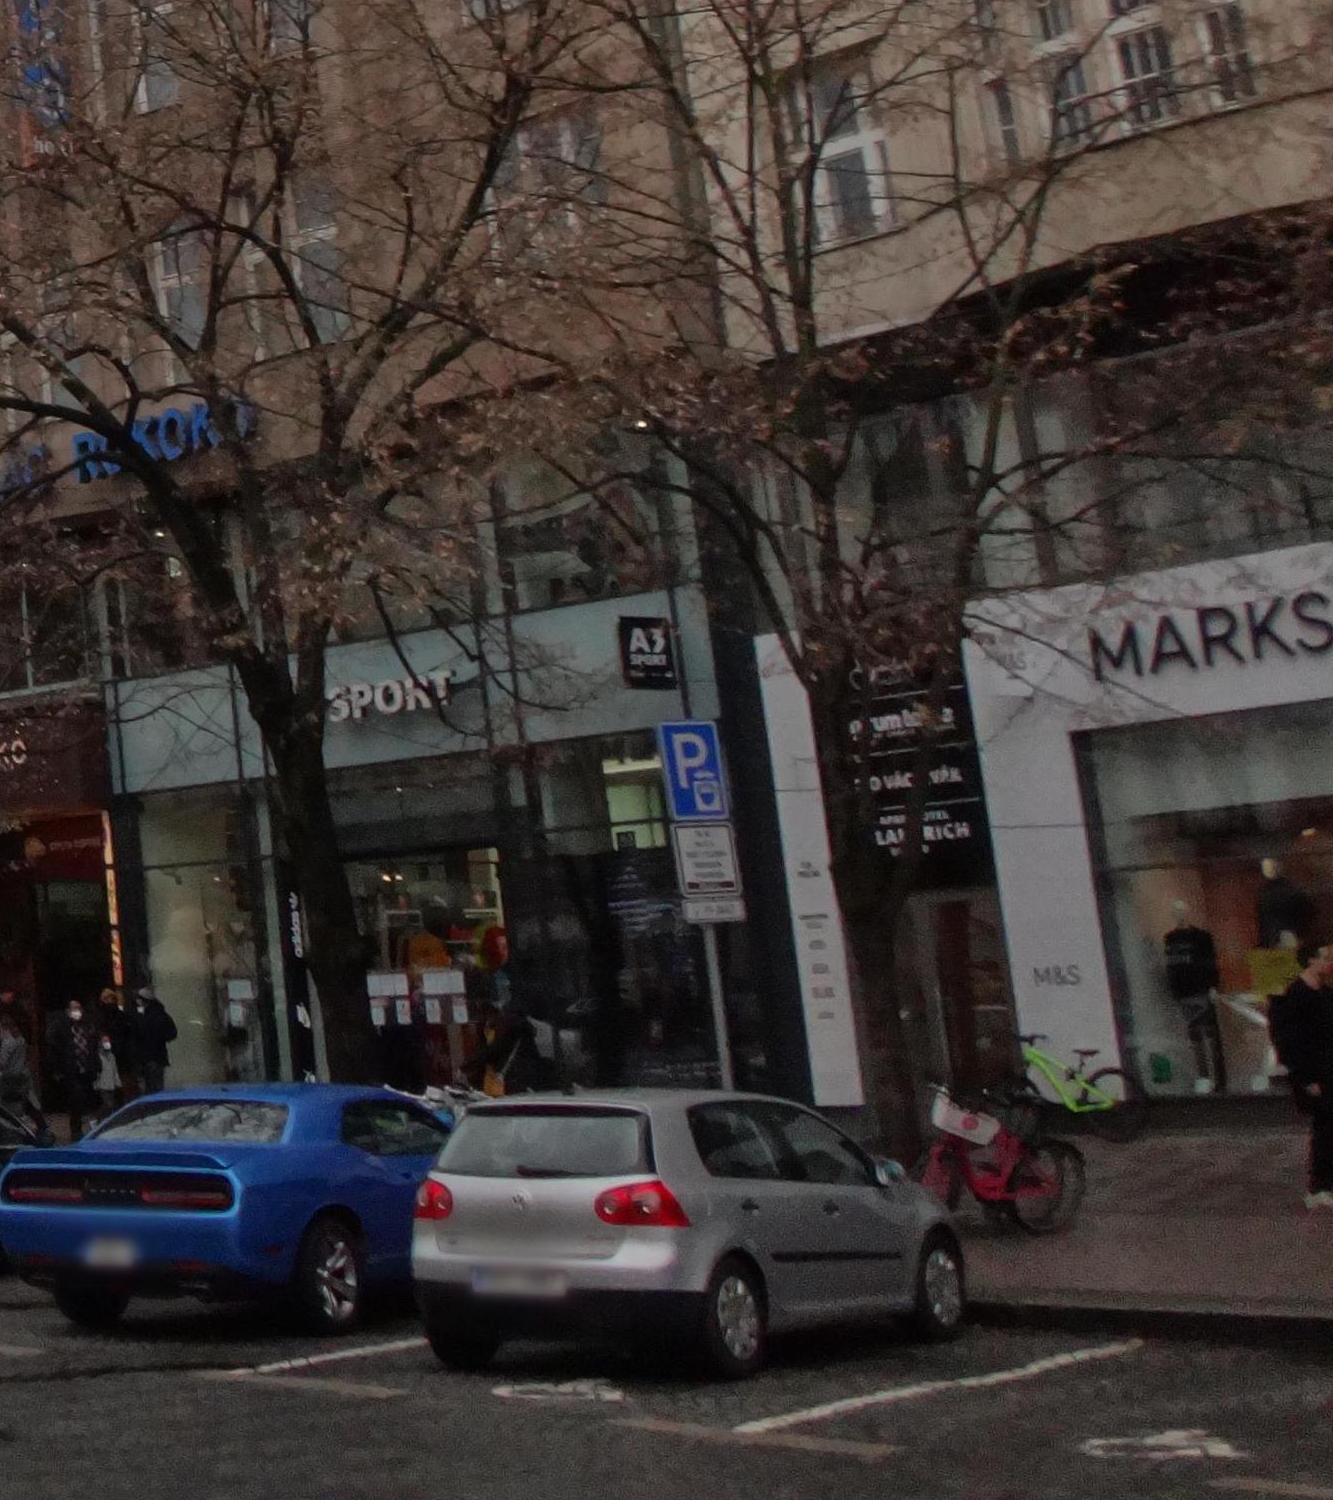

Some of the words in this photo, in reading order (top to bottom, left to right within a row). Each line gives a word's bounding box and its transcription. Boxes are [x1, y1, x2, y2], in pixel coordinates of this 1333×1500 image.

[73, 398, 255, 485] RKOK
[629, 627, 666, 653] A3
[1087, 591, 1333, 682] MARKS
[326, 666, 454, 723] SPORT
[672, 732, 710, 789] P
[1033, 964, 1082, 988] M&S
